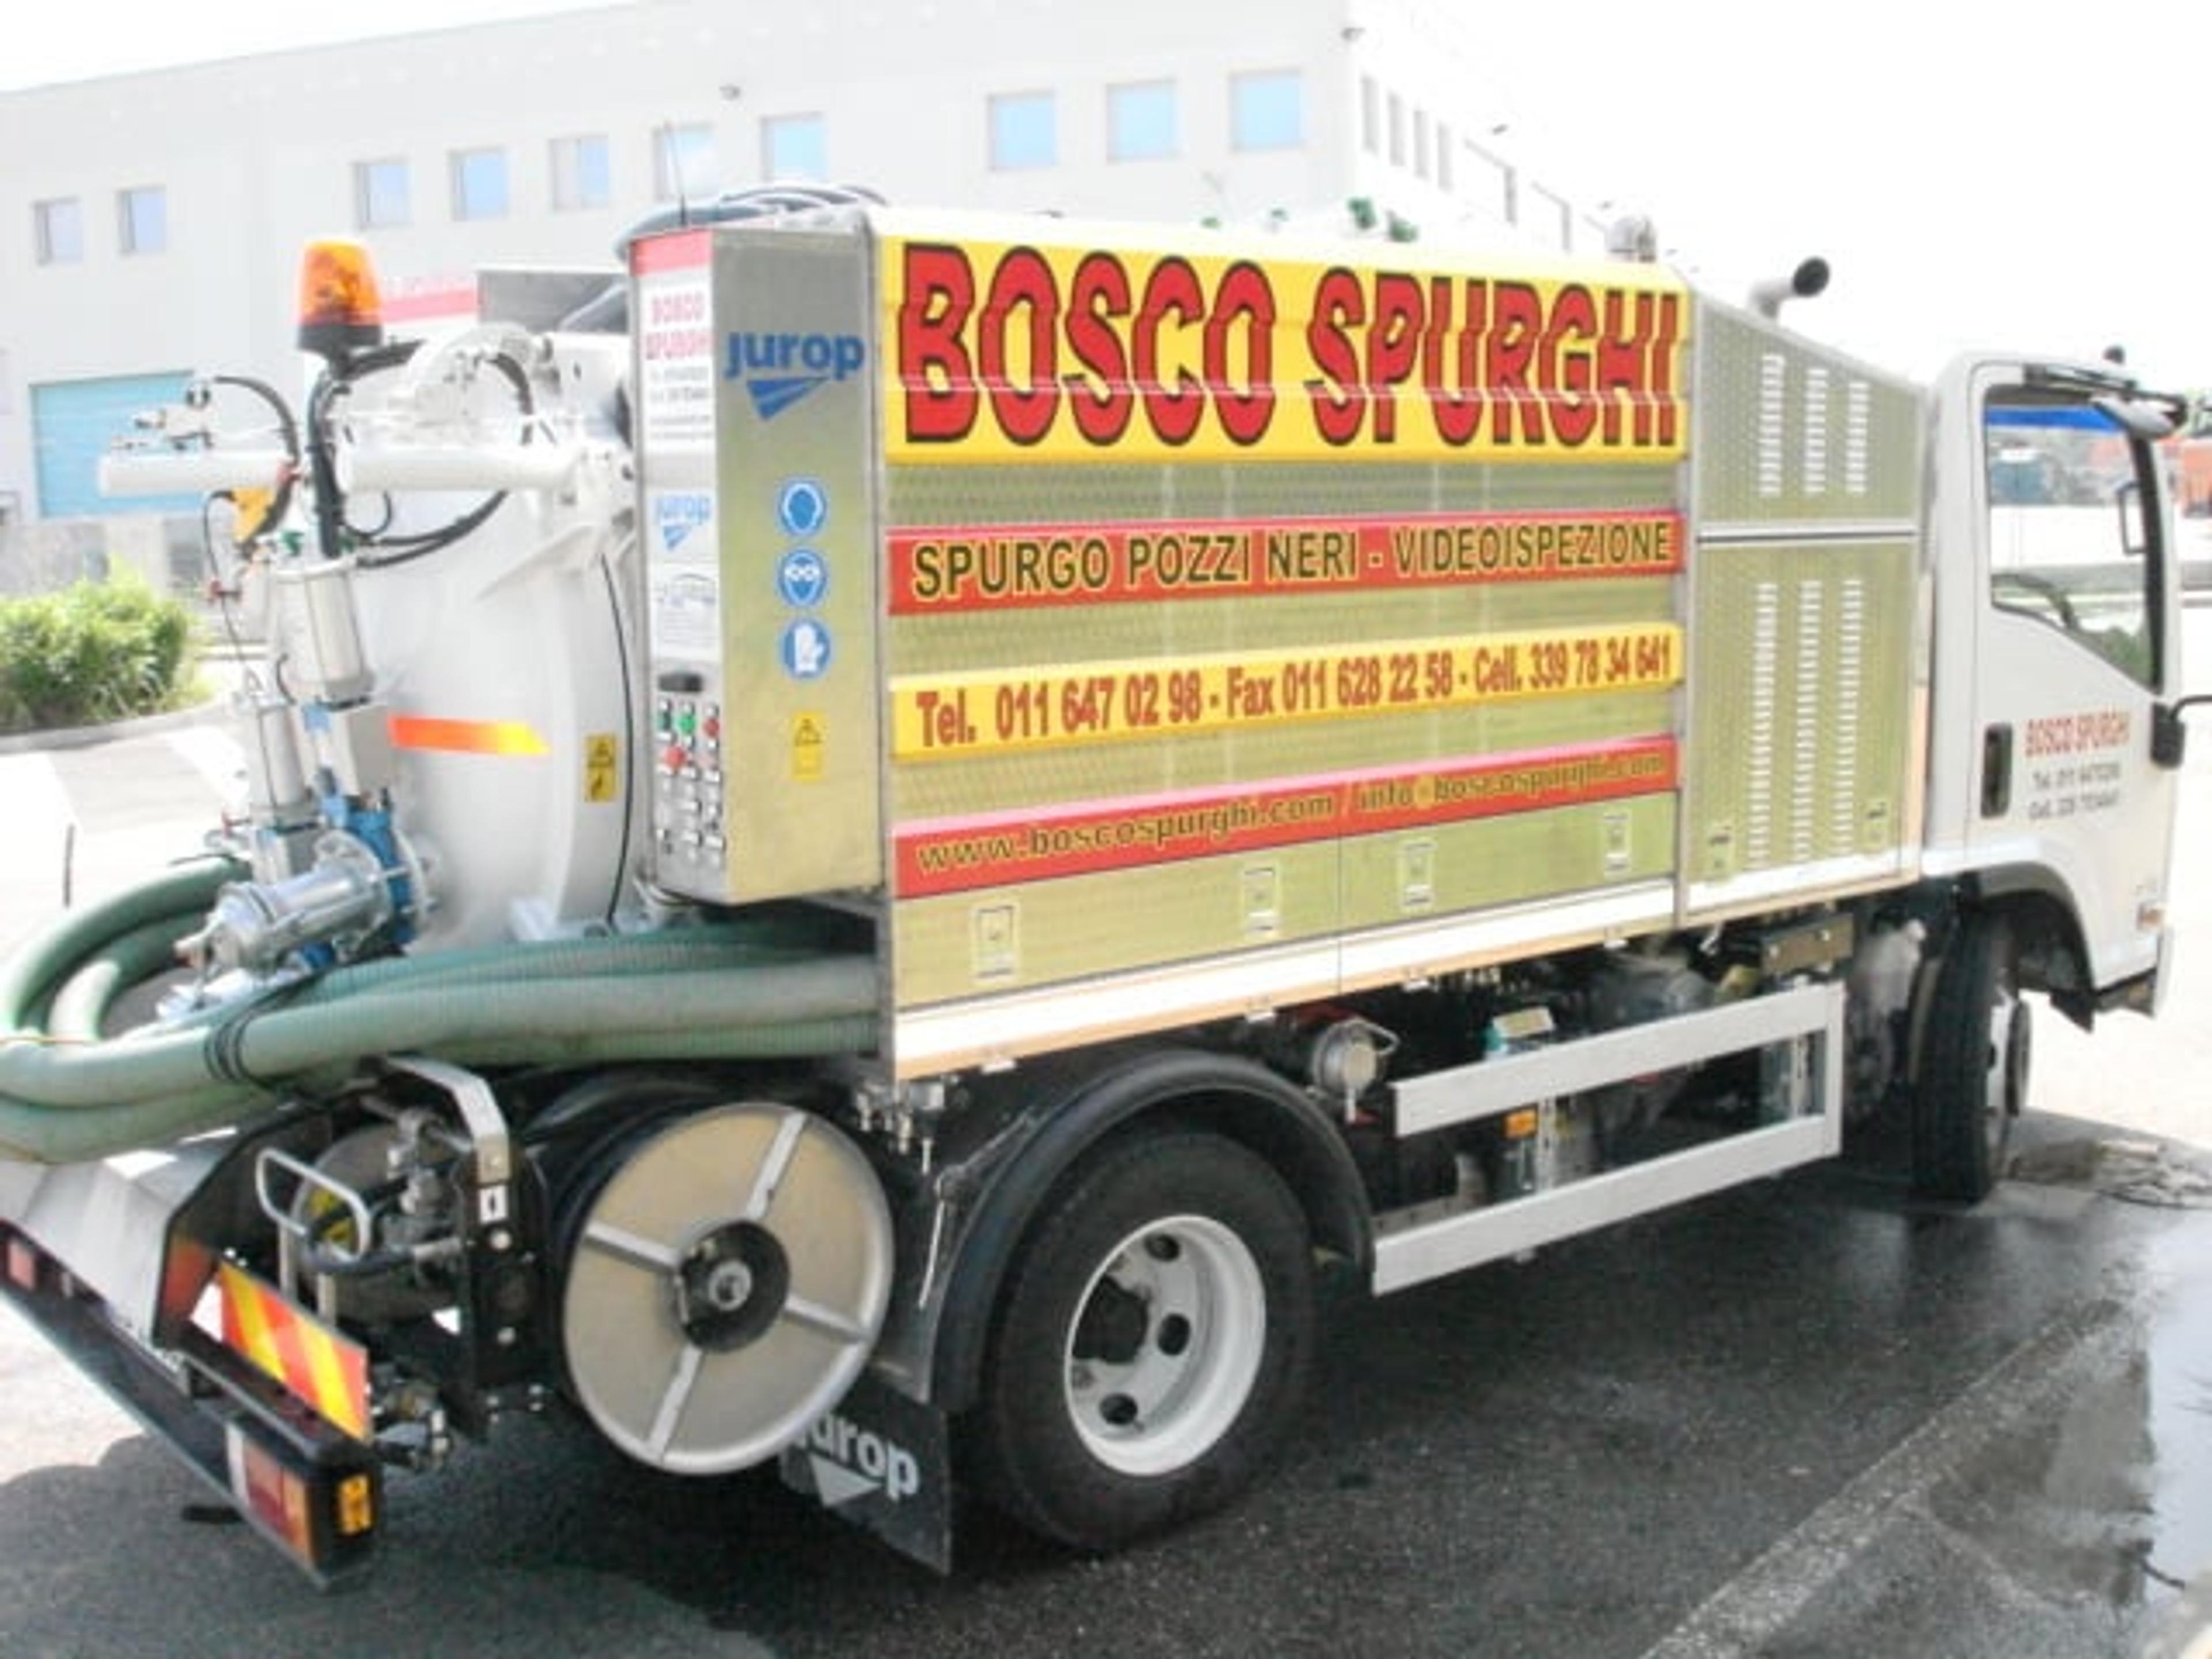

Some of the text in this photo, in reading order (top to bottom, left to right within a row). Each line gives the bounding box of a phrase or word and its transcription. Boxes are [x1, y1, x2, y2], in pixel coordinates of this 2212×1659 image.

[899, 242, 1678, 446] BOSCO SPURGHI
[914, 536, 1112, 600] SPURGO
[1126, 533, 1251, 587] POZZI
[1267, 529, 1358, 581] NERI
[1394, 521, 1671, 574] VIDEOISPEZIONE
[915, 688, 976, 748] Tel.
[995, 681, 1050, 740] 011
[1061, 675, 1115, 734] 647
[1124, 672, 1160, 727] 02
[1168, 668, 1202, 723] 98
[1227, 666, 1273, 719] Fax
[1282, 659, 1327, 713] 011
[1336, 656, 1381, 706] 628
[1388, 653, 1418, 702] 22
[1425, 649, 1453, 697] 58
[1475, 644, 1522, 693] Cell.
[1529, 639, 1569, 689] 339
[1575, 638, 1601, 685] 78
[1605, 635, 1630, 683] 34
[1635, 632, 1671, 680] 641
[919, 791, 1333, 870] www.boscospurghi.com
[795, 1411, 919, 1501] urop
